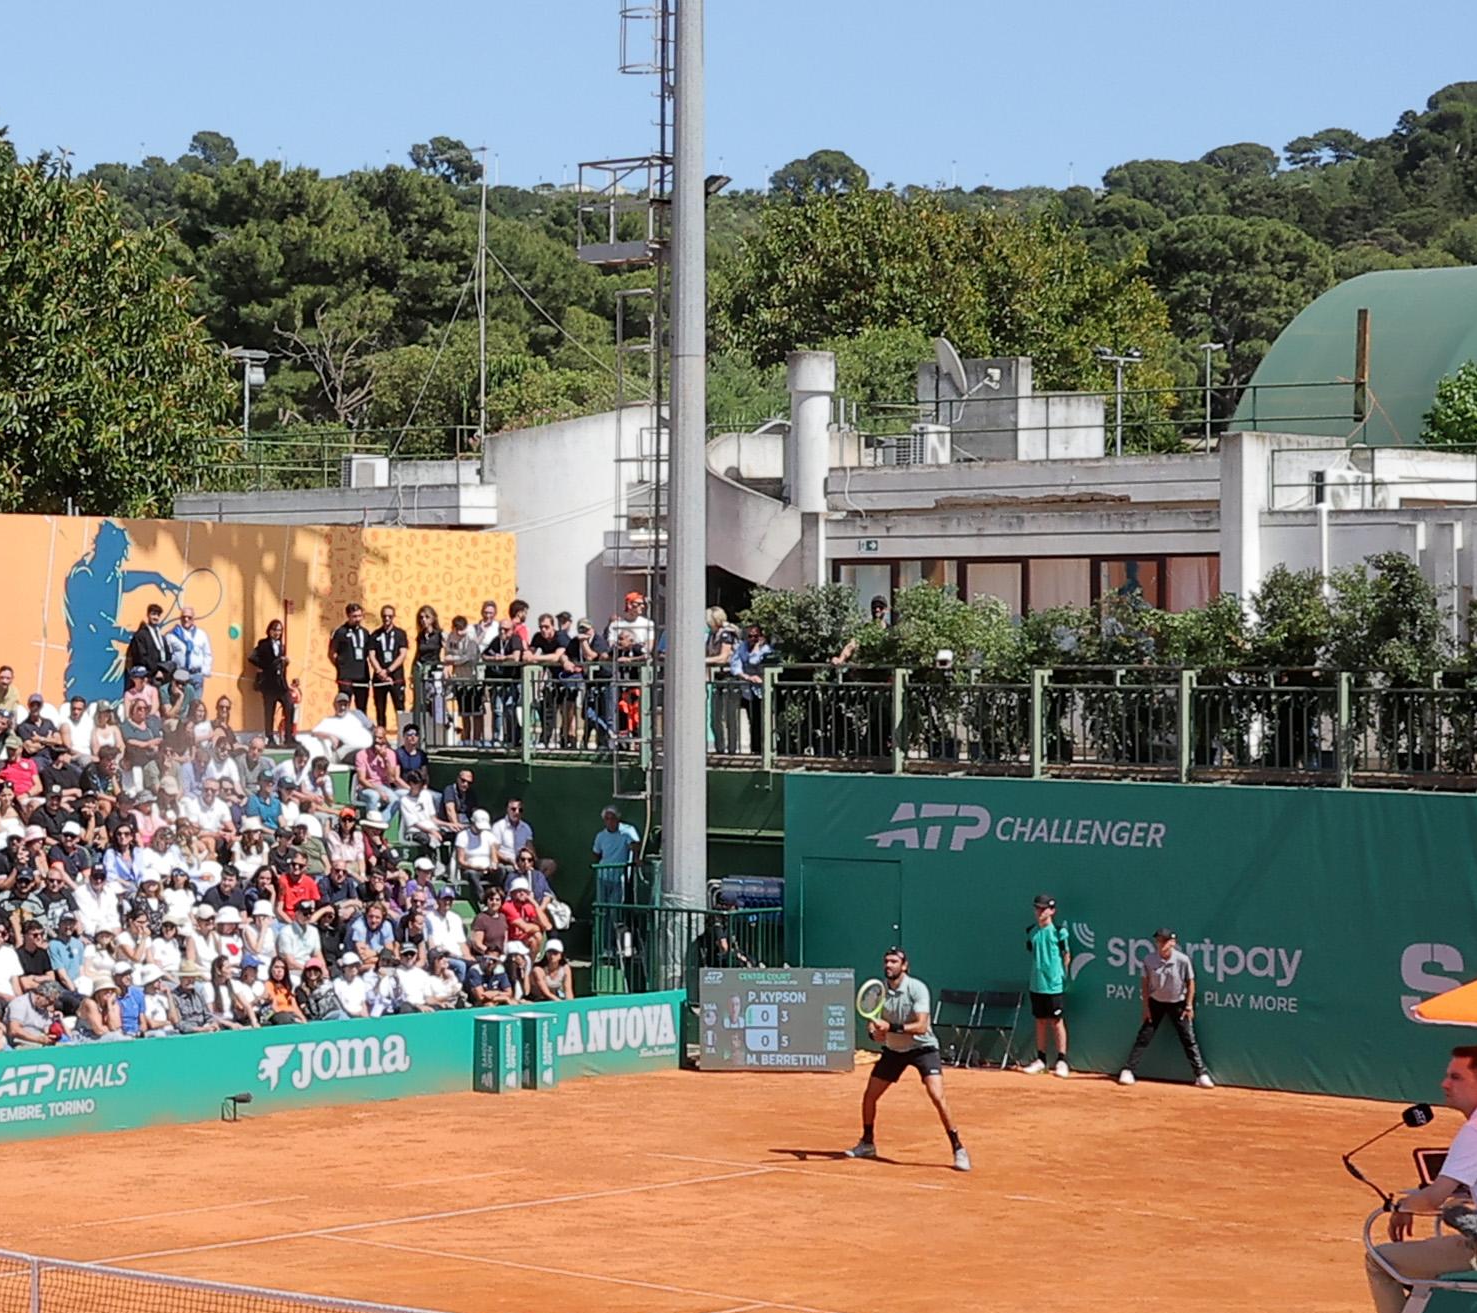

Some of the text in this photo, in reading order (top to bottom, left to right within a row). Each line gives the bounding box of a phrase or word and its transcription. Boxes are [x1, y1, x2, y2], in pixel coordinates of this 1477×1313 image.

[866, 802, 1166, 851] ATP CHALLENGER
[1107, 936, 1302, 987] sprtpay
[760, 991, 807, 1004] KYPSON
[1105, 983, 1134, 1000] PAY
[1204, 992, 1244, 1009] PLAY
[1249, 995, 1298, 1013] MORE
[761, 1010, 769, 1022] 0
[781, 1010, 789, 1022] 3
[586, 1003, 677, 1053] NUOVA
[761, 1035, 769, 1047] 0
[781, 1035, 789, 1047] 5
[747, 1053, 827, 1066] M. BERRETTINI
[56, 1061, 130, 1092] FINALS
[47, 1097, 95, 1119] TORINO
